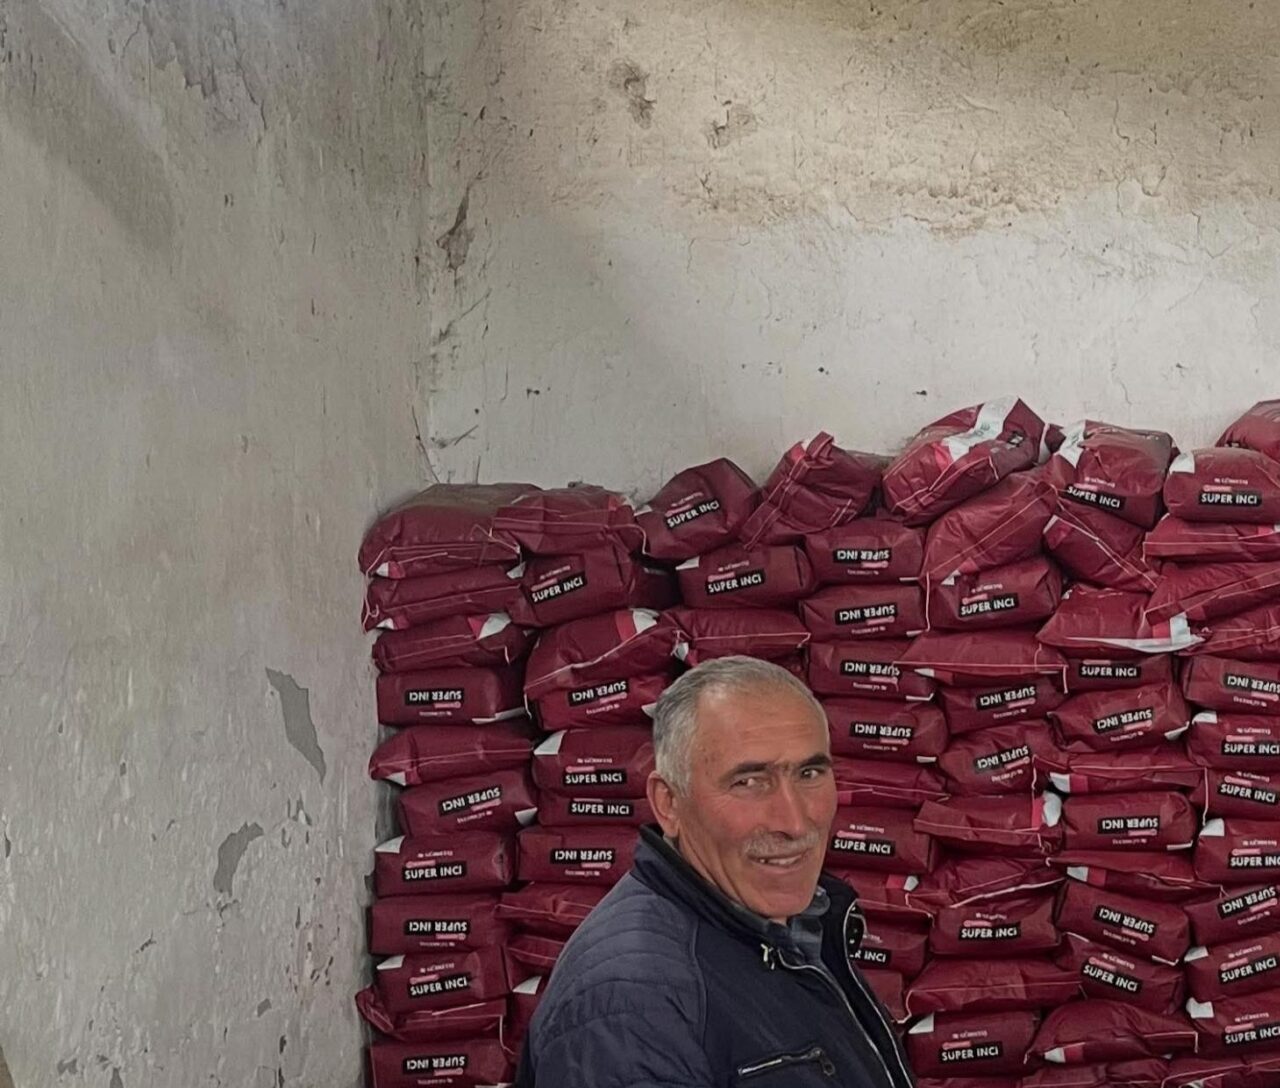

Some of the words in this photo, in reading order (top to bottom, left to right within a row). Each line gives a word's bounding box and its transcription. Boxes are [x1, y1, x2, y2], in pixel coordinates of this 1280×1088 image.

[1065, 485, 1097, 502] SUPER
[1201, 492, 1233, 503] SUPER
[1235, 493, 1257, 504] INCI
[666, 508, 699, 527] SUPER
[699, 499, 721, 514] INCI
[836, 549, 858, 560] INCI
[859, 549, 889, 560] SUPER
[530, 584, 561, 602] SUPER
[562, 576, 583, 591] INCI
[707, 578, 739, 593] SUPER
[739, 573, 762, 586] INCI
[863, 604, 895, 618] SUPER
[960, 601, 991, 615] SUPER
[992, 597, 1015, 609] INCI
[838, 609, 861, 621] INCI
[868, 663, 900, 676] SUPER
[1081, 665, 1112, 676] SUPER
[1114, 667, 1137, 677] INCI
[1226, 675, 1249, 687] INCI
[1250, 678, 1280, 693] SUPER
[571, 688, 594, 701] INCI
[595, 680, 626, 696] SUPER
[1003, 685, 1035, 701] SUPER
[408, 691, 429, 701] INCI
[431, 690, 462, 701] SUPER
[979, 693, 1002, 706] INCI
[1096, 715, 1119, 729] INCI
[1119, 708, 1152, 723] SUPER
[854, 723, 877, 734] INCI
[879, 725, 911, 737] SUPER
[999, 745, 1029, 762] SUPER
[1223, 742, 1256, 754] SUPER
[1257, 743, 1280, 754] INCI
[976, 755, 999, 769] INCI
[565, 773, 598, 784] SUPER
[600, 772, 622, 782] INCI
[466, 786, 500, 804] SUPER
[1220, 783, 1252, 798] SUPER
[1253, 789, 1276, 803] INCI
[441, 796, 465, 811] INCI
[571, 802, 604, 814] SUPER
[606, 804, 629, 815] INCI
[1101, 818, 1124, 829] INCI
[1126, 817, 1158, 828] SUPER
[834, 838, 866, 851] SUPER
[868, 843, 891, 854] INCI
[554, 850, 577, 860] INCI
[579, 850, 612, 860] SUPER
[1230, 856, 1262, 867] SUPER
[404, 867, 437, 880] SUPER
[439, 864, 462, 876] INCI
[1243, 886, 1276, 905] SUPER
[1221, 897, 1244, 913] INCI
[1098, 907, 1121, 923] INCI
[408, 921, 431, 931] INCI
[434, 921, 467, 931] SUPER
[1122, 915, 1154, 933] SUPER
[961, 927, 993, 938] SUPER
[995, 927, 1017, 938] INCI
[864, 950, 886, 963] INCI
[1220, 964, 1253, 982] SUPER
[1254, 956, 1277, 971] INCI
[1082, 964, 1114, 984] SUPER
[1115, 976, 1138, 991] INCI
[409, 981, 442, 995] SUPER
[444, 976, 468, 989] INCI
[1224, 1030, 1257, 1044] SUPER
[941, 1048, 974, 1061] SUPER
[976, 1046, 999, 1057] INCI
[406, 1058, 429, 1070] INCI
[431, 1055, 465, 1068] SUPER
